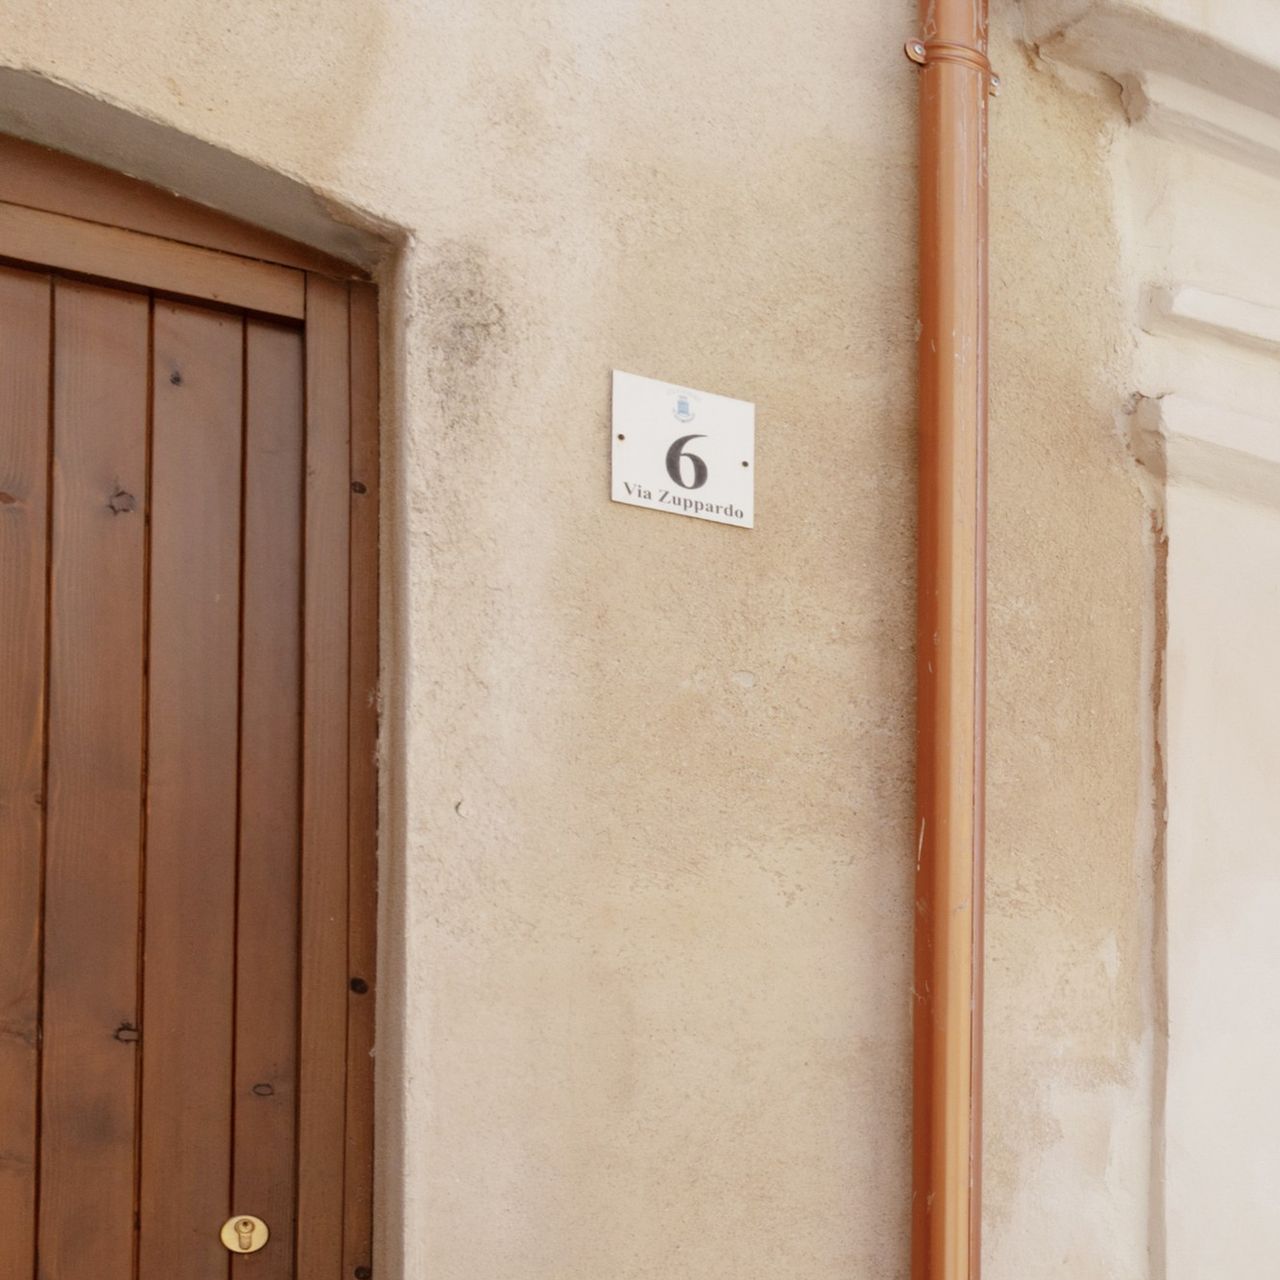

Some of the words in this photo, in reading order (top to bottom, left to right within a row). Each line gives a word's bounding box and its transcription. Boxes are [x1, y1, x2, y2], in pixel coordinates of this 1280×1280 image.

[665, 434, 708, 490] 6
[623, 481, 652, 500] Via
[658, 489, 744, 520] Zuppardo
